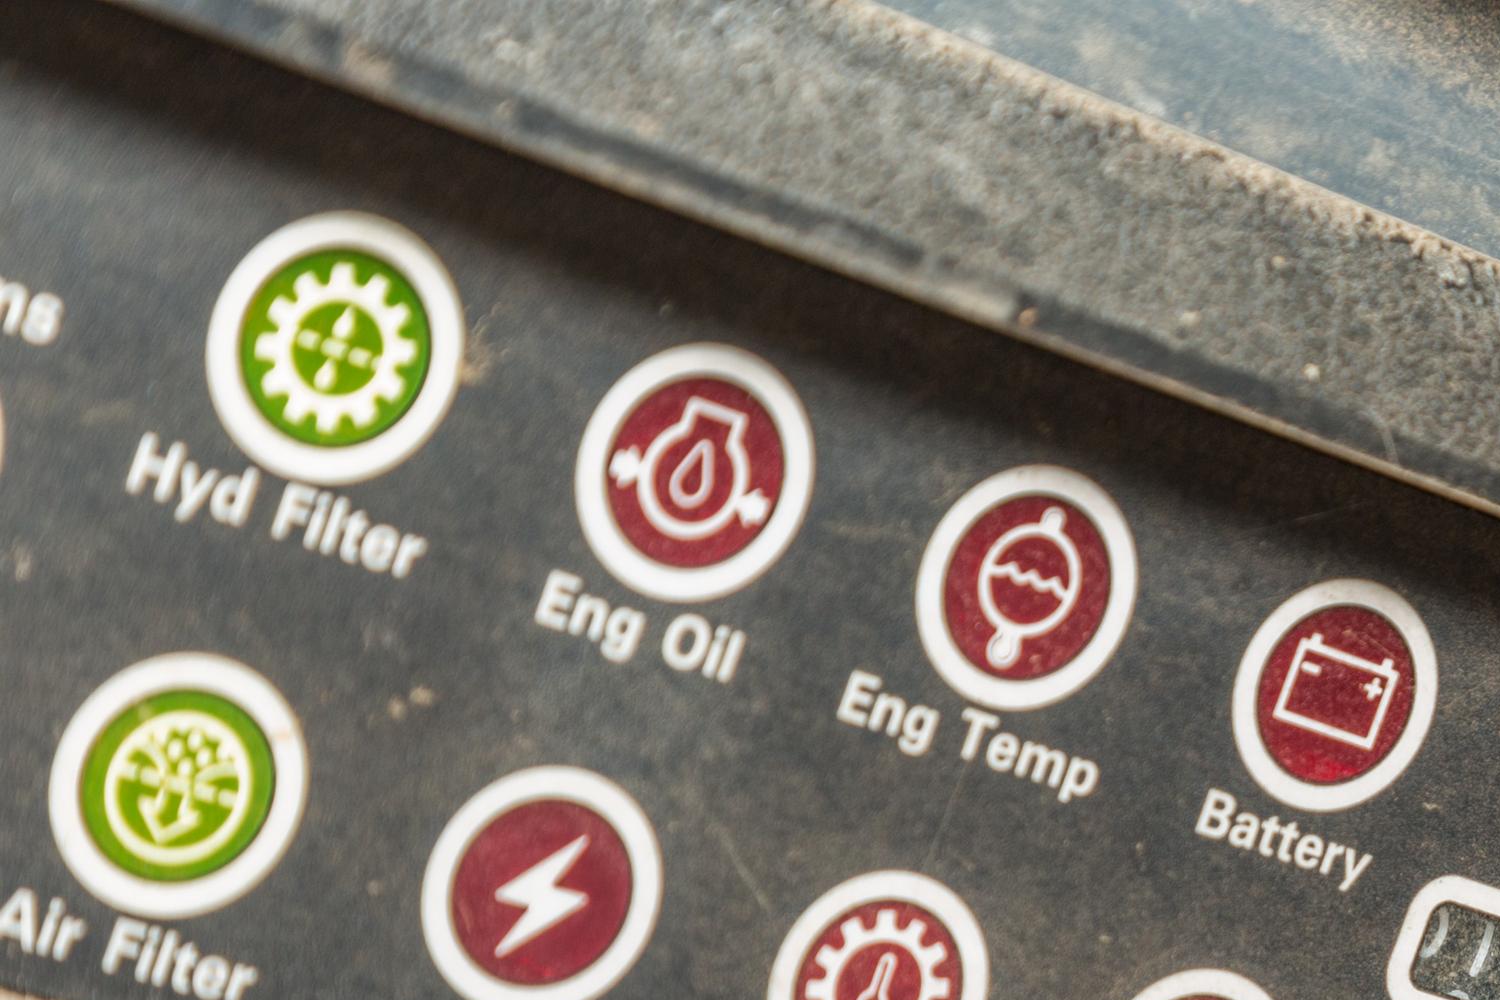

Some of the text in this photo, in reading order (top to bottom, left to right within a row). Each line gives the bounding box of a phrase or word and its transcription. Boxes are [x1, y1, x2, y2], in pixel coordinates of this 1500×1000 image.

[125, 431, 428, 579] Hyd Filter
[534, 568, 747, 684] Eng Oil
[836, 669, 1100, 804] Eng Temp
[1195, 788, 1373, 892] Battery
[0, 887, 87, 962] Air
